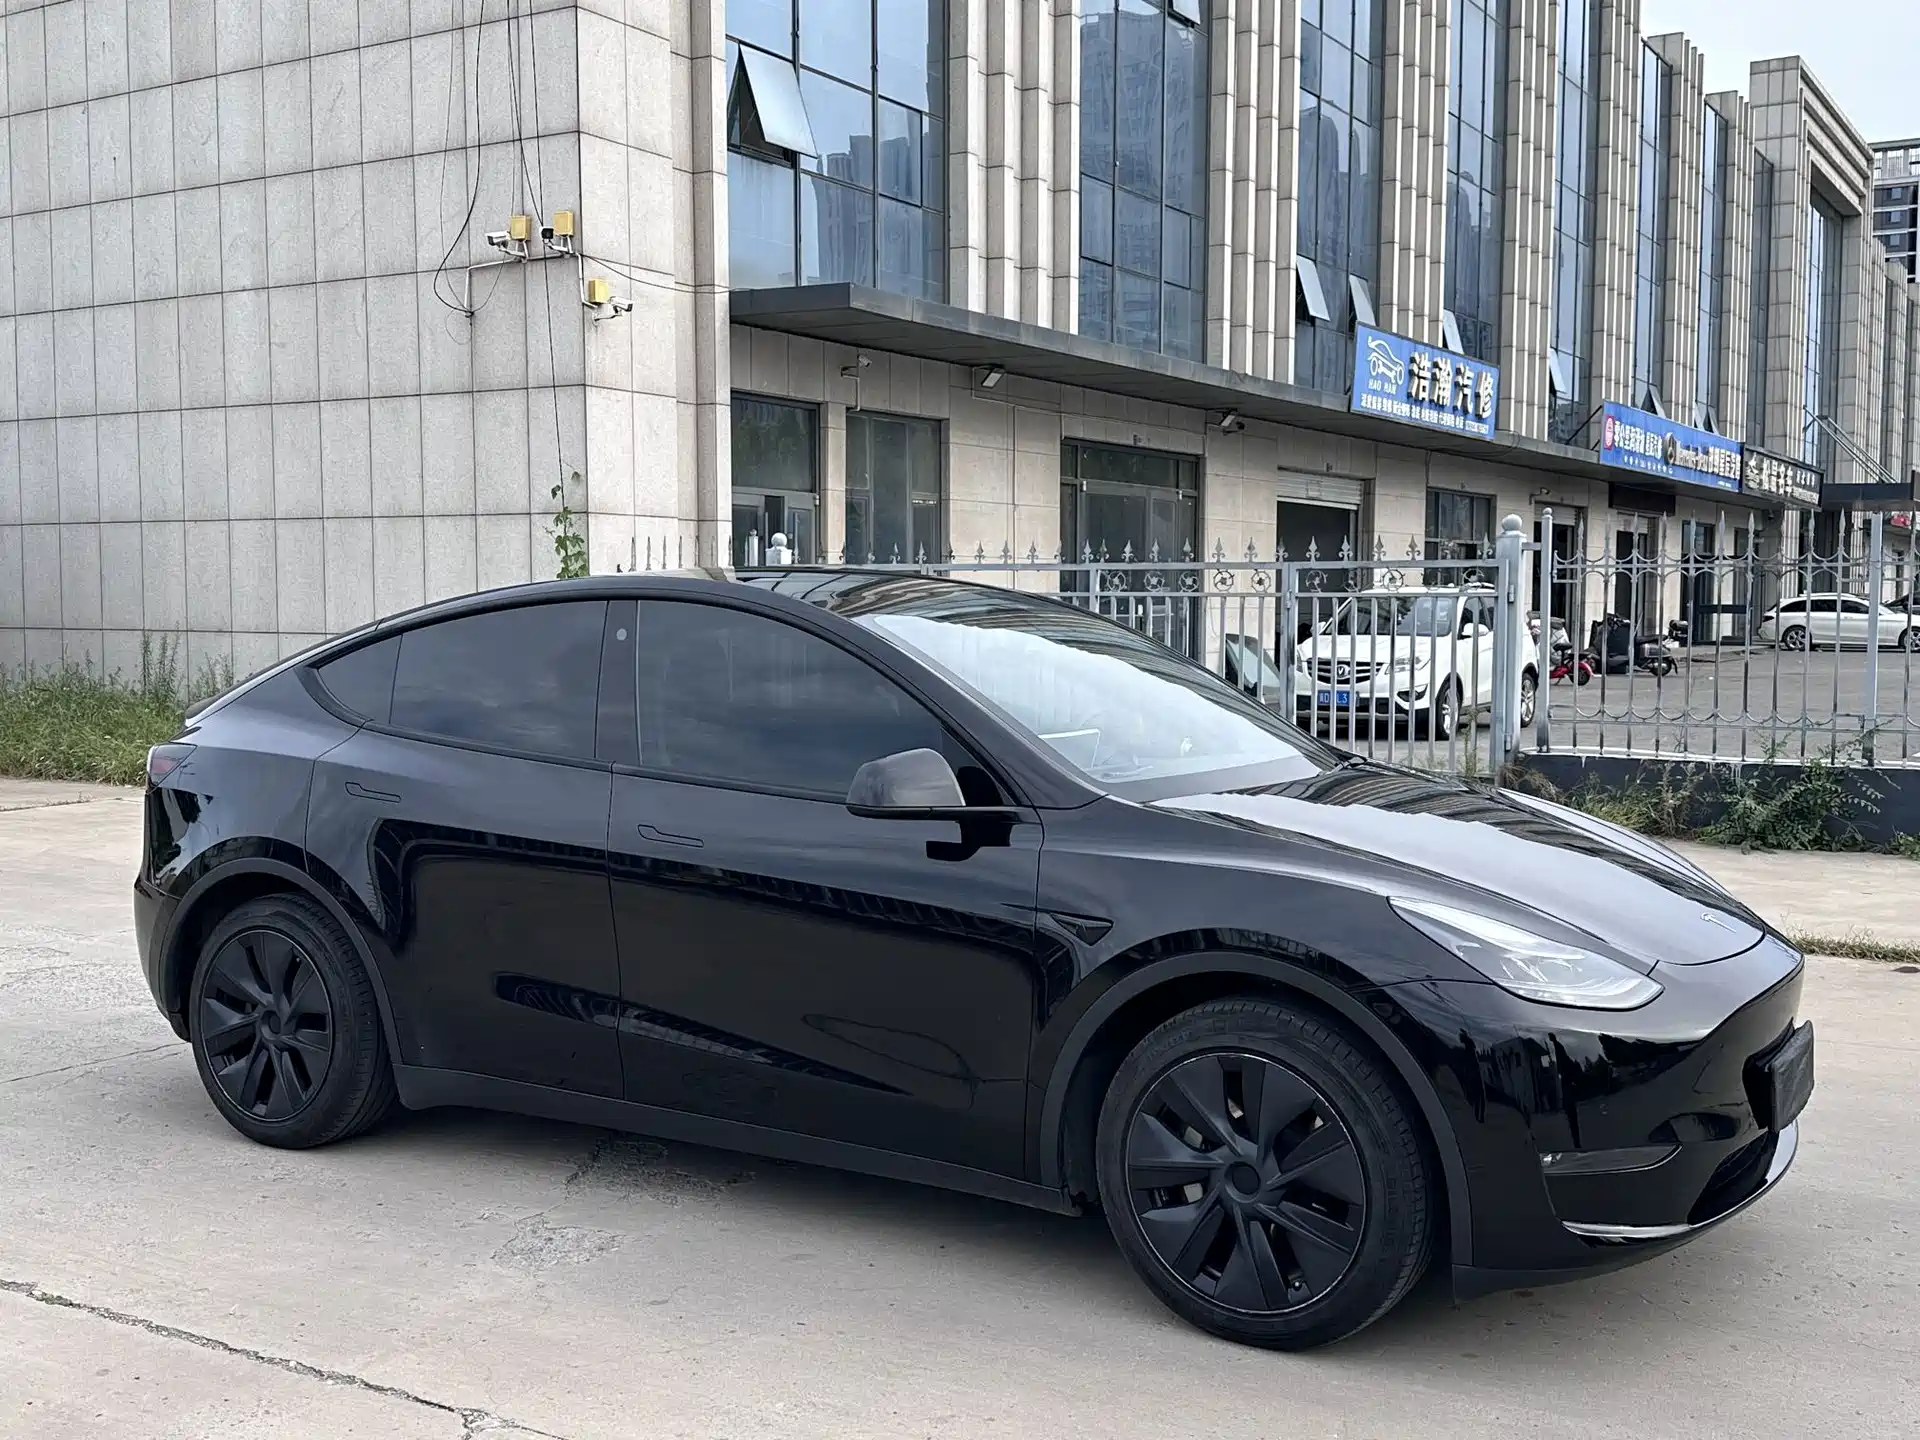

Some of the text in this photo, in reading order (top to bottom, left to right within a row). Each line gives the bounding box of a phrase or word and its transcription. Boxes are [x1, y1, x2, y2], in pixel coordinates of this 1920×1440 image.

[1368, 378, 1381, 392] HAO
[1408, 351, 1494, 419] 浩瀚汽修
